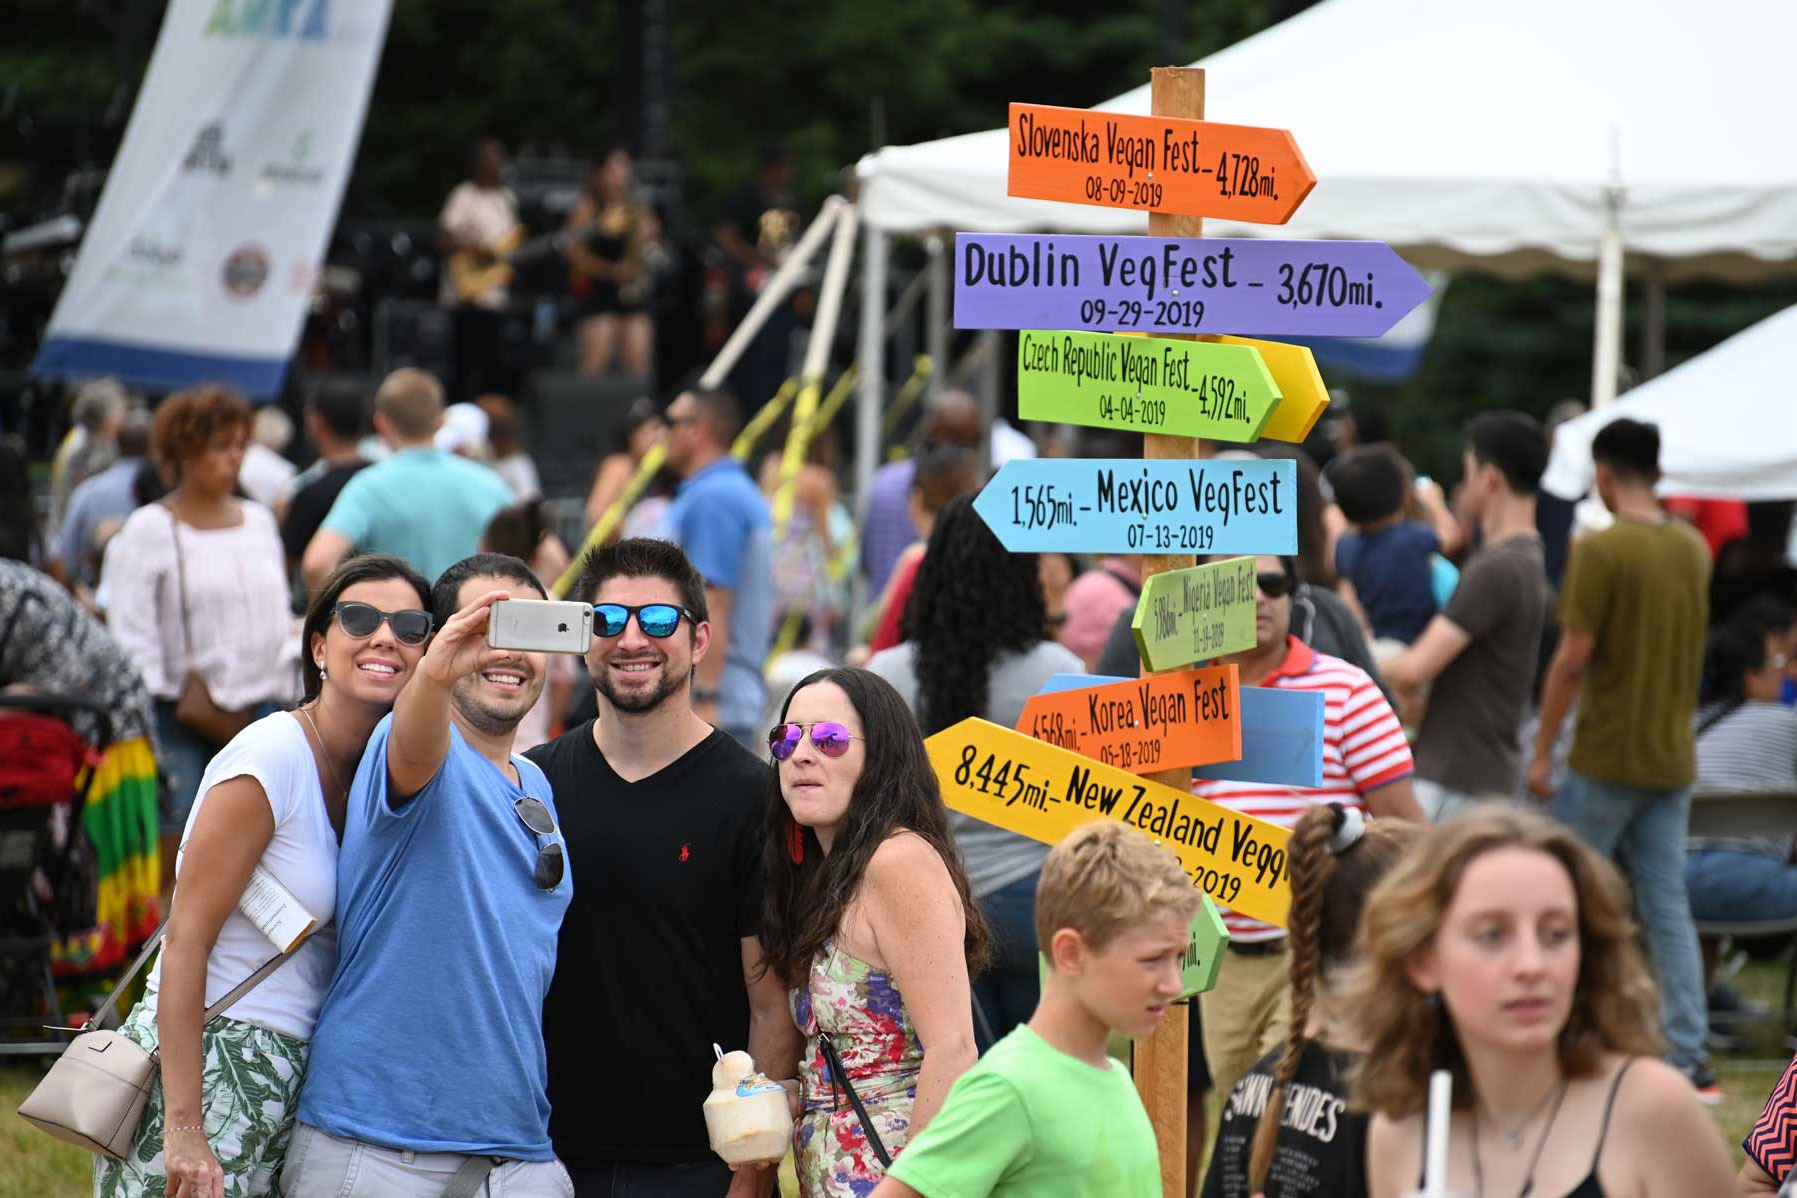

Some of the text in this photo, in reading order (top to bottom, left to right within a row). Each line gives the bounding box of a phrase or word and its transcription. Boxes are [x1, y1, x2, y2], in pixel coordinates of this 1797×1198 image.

[1018, 112, 1099, 163] Slovenska
[1163, 129, 1200, 173] Fest
[1085, 176, 1162, 207] 08-09-2019
[964, 242, 1079, 287] Dublin
[1080, 299, 1205, 328] 09-29-2019
[1023, 333, 1058, 372] Czech
[1063, 336, 1117, 387] Republic
[1163, 346, 1190, 390] Fest
[1100, 395, 1166, 426] 04-04-2019
[1097, 467, 1178, 515] Mexico
[1127, 524, 1214, 549] 07-13-2019
[1183, 573, 1210, 626] Nigeria
[1238, 565, 1254, 605] Fest
[1089, 693, 1134, 735] Korea
[1193, 676, 1229, 724] Fest
[1065, 765, 1122, 816] New
[1121, 785, 1224, 856] Zealand
